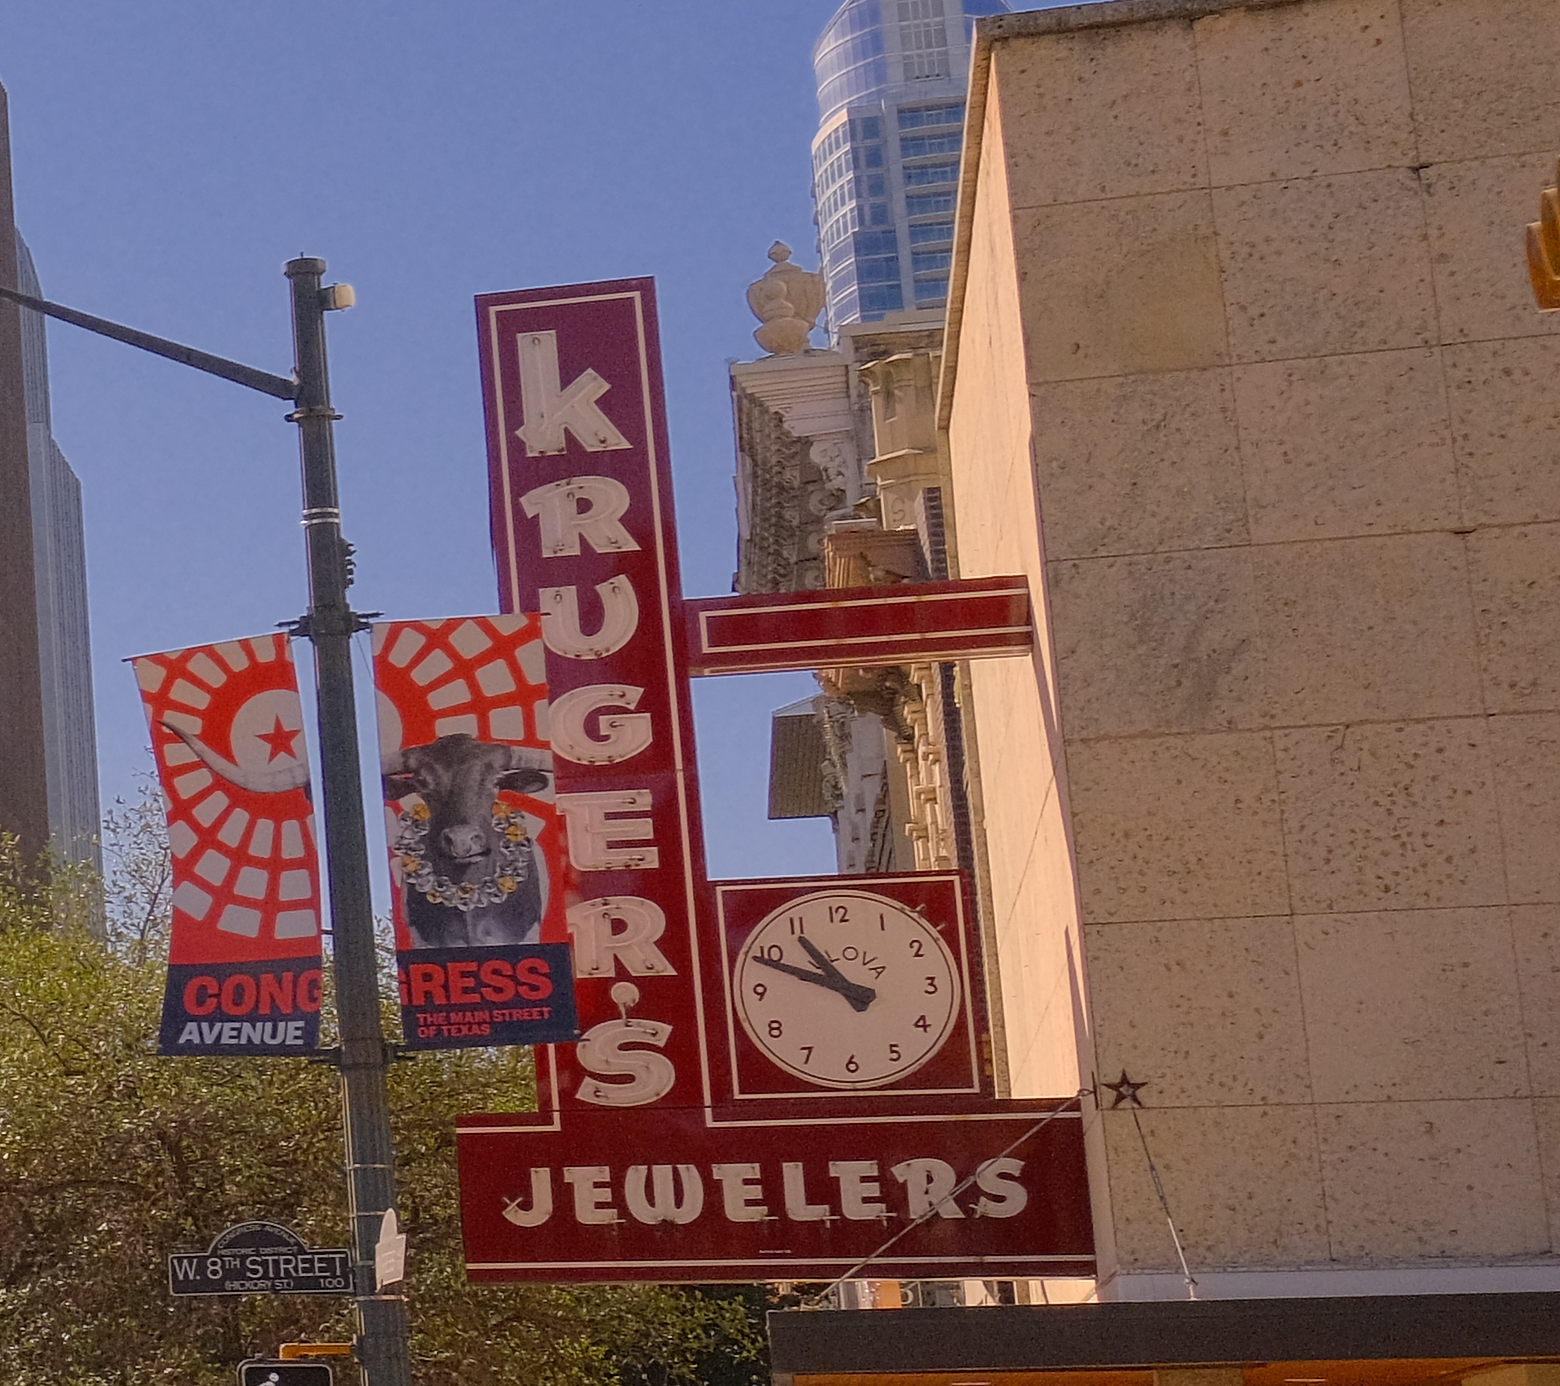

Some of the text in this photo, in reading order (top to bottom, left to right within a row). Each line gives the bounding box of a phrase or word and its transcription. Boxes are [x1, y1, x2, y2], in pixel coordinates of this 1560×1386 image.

[515, 330, 675, 1107] KRUGER'S
[829, 905, 849, 923] 12
[880, 913, 885, 931] 1
[790, 917, 804, 935] 11
[759, 945, 783, 963] 10
[909, 940, 926, 957] 2
[398, 957, 555, 1007] RESS
[924, 976, 938, 994] 3
[753, 983, 767, 1001] 9
[416, 1007, 550, 1025] THE MAIN STREET
[913, 1015, 931, 1032] 4
[179, 1020, 305, 1046] AVENUE
[417, 1024, 491, 1038] OF TEXAS
[768, 1020, 782, 1038] 8
[800, 1047, 814, 1064] 7
[889, 1044, 901, 1061] 5
[846, 1055, 859, 1072] 6
[501, 1156, 1028, 1227] JEWELERS
[217, 1246, 299, 1256] HISTORIC DISTRICT
[172, 1258, 201, 1281] W.
[245, 1254, 346, 1279] STREET
[225, 1280, 271, 1291] (HICKORY
[320, 1278, 344, 1288] 100
